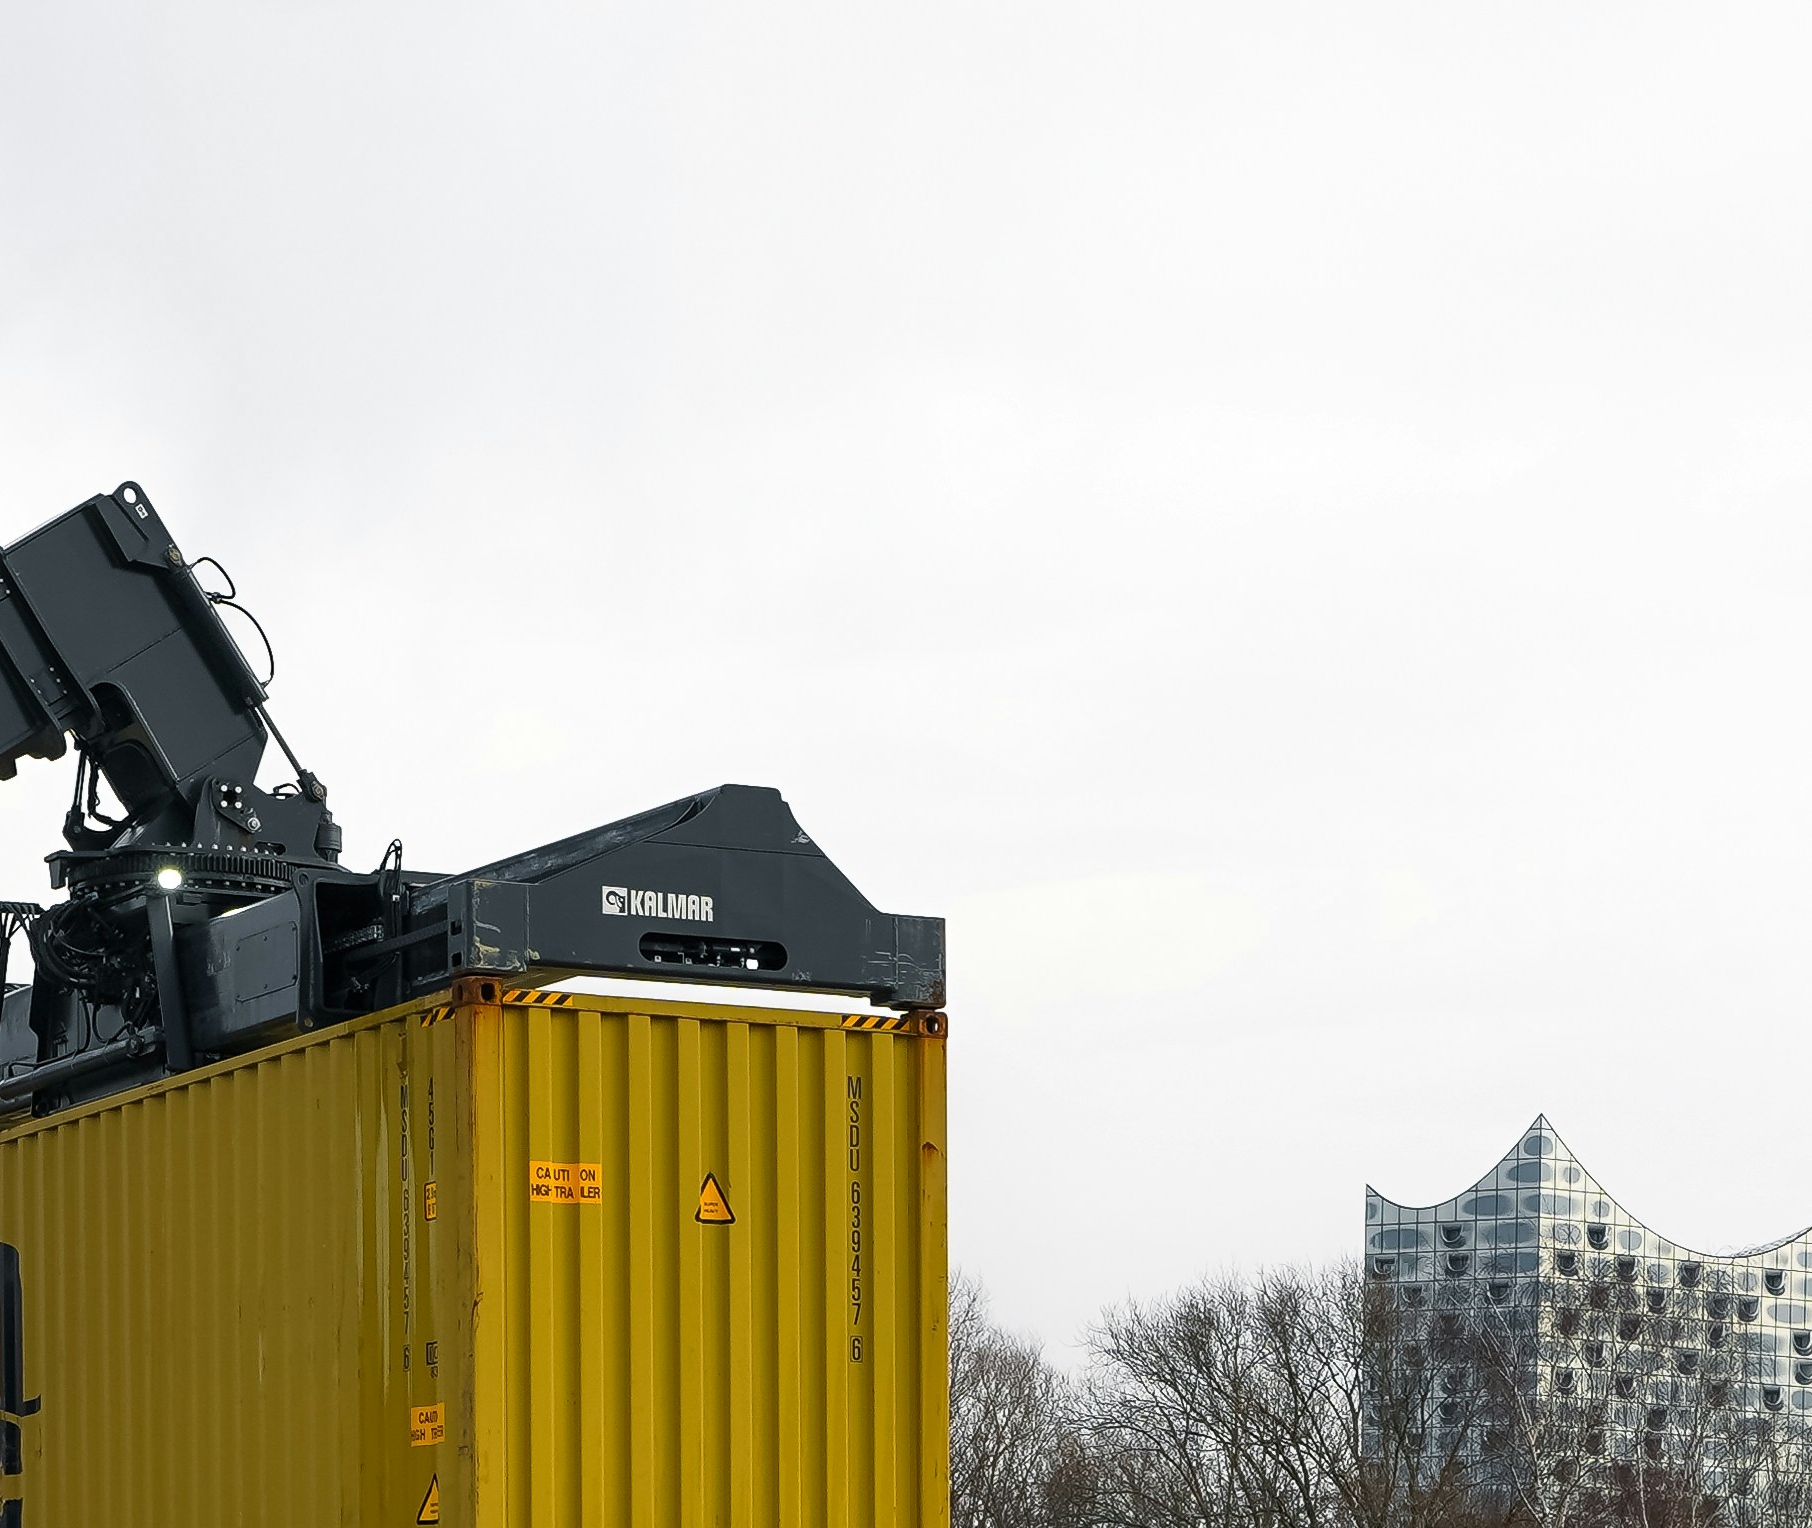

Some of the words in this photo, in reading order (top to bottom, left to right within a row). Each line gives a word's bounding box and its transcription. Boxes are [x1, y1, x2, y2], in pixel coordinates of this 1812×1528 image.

[630, 889, 714, 922] KALMAR
[848, 1075, 862, 1172] MSDU
[536, 1166, 596, 1182] CAUTION
[553, 1185, 601, 1200] TRAILER
[851, 1181, 862, 1326] 639457
[851, 1337, 862, 1362] 6
